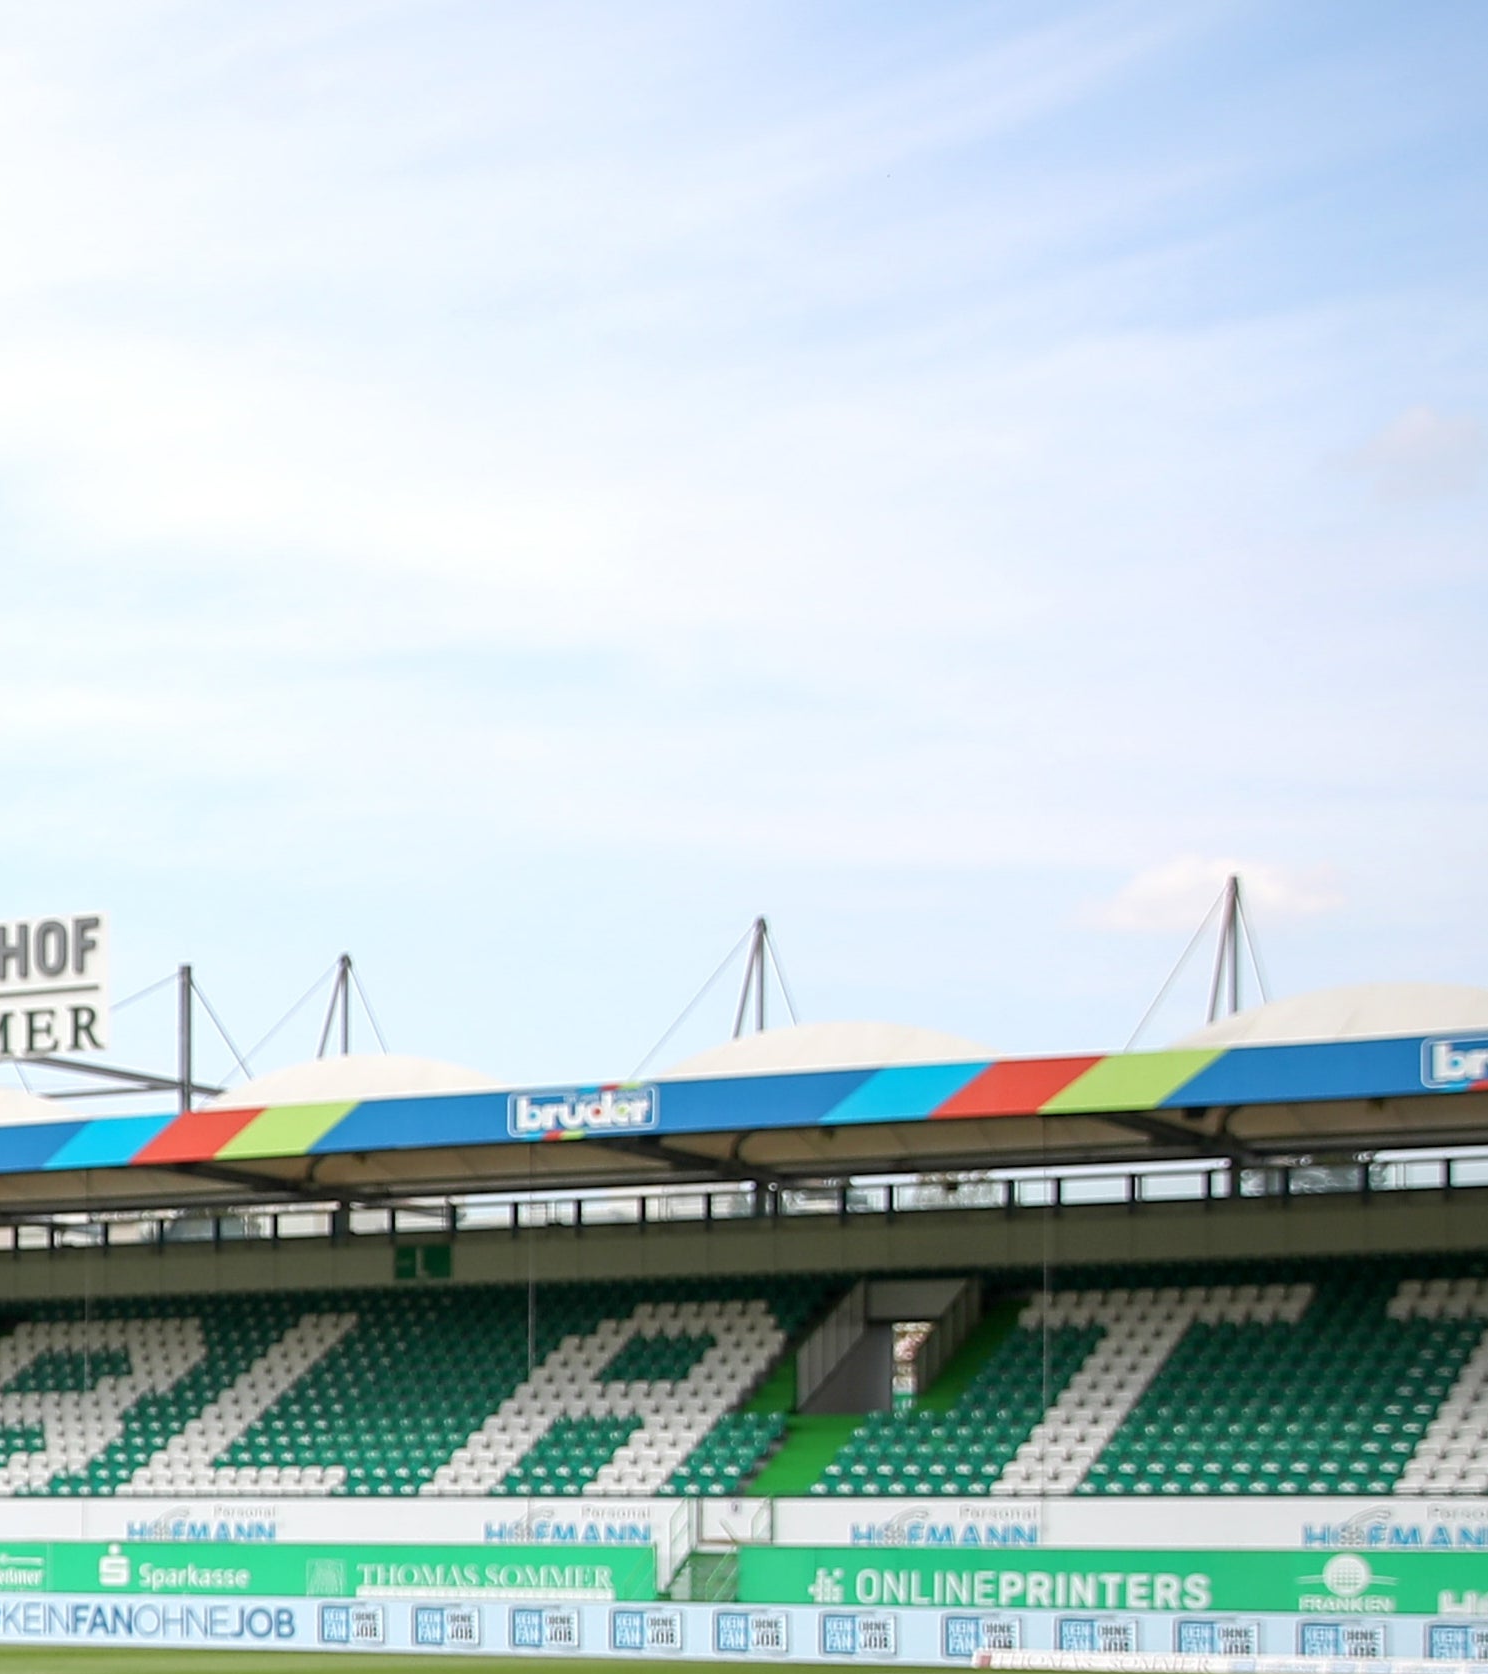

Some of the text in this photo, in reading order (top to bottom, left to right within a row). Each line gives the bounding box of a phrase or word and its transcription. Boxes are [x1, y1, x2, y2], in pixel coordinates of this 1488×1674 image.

[515, 1091, 650, 1132] bruder
[138, 1563, 251, 1590] Sparkasse
[356, 1563, 615, 1588] THOMAS SOMMER
[855, 1568, 1213, 1610] ONLINEPRINTERS
